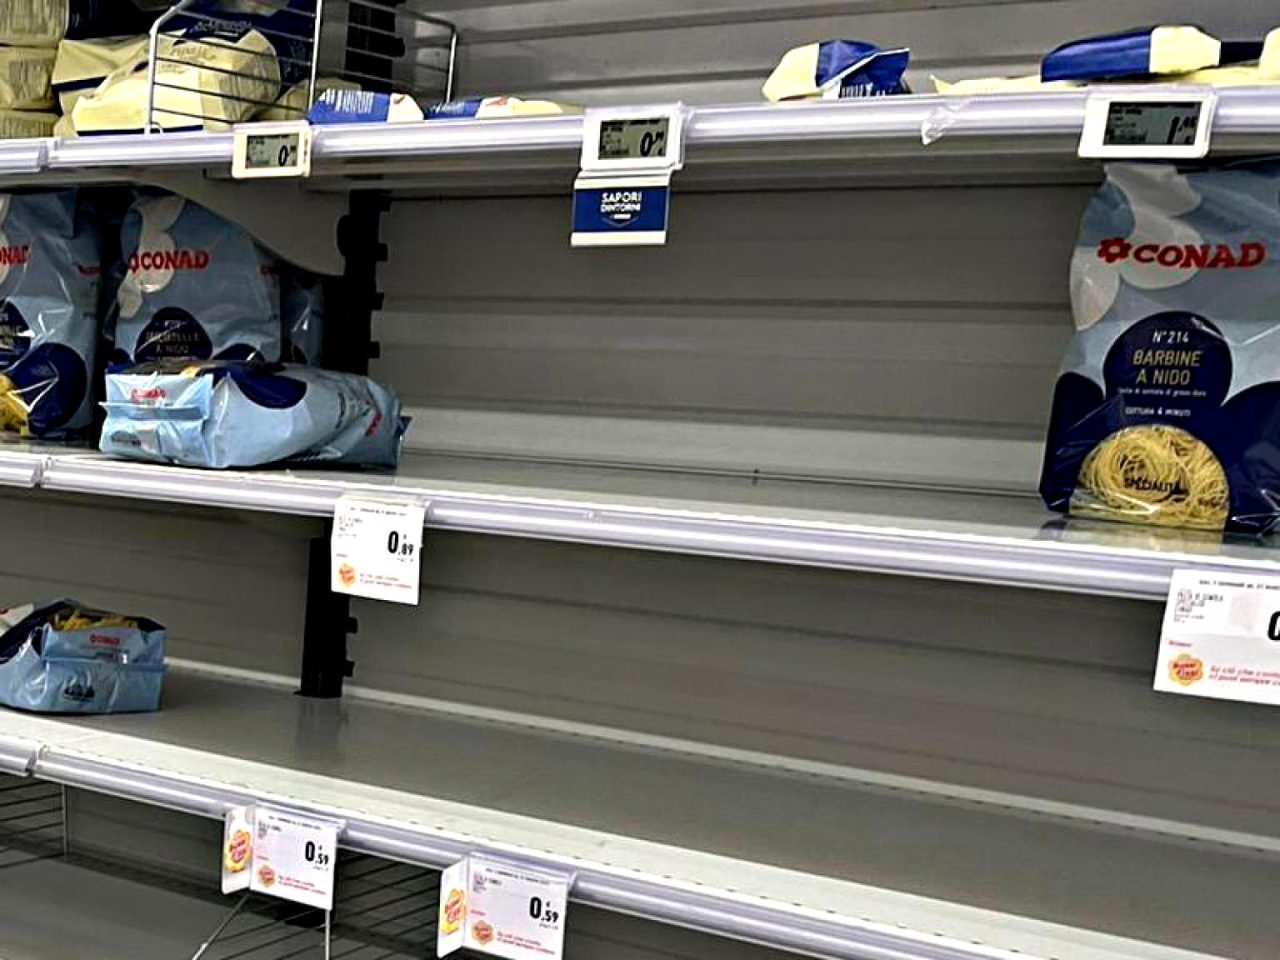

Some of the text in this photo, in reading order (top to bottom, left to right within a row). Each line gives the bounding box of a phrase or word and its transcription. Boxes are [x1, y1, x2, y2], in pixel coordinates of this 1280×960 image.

[601, 191, 642, 203] SAPORI
[139, 250, 209, 271] CONAD
[1133, 243, 1265, 269] CONAD
[1133, 349, 1201, 367] BARBINE
[1136, 369, 1191, 385] A NIDO
